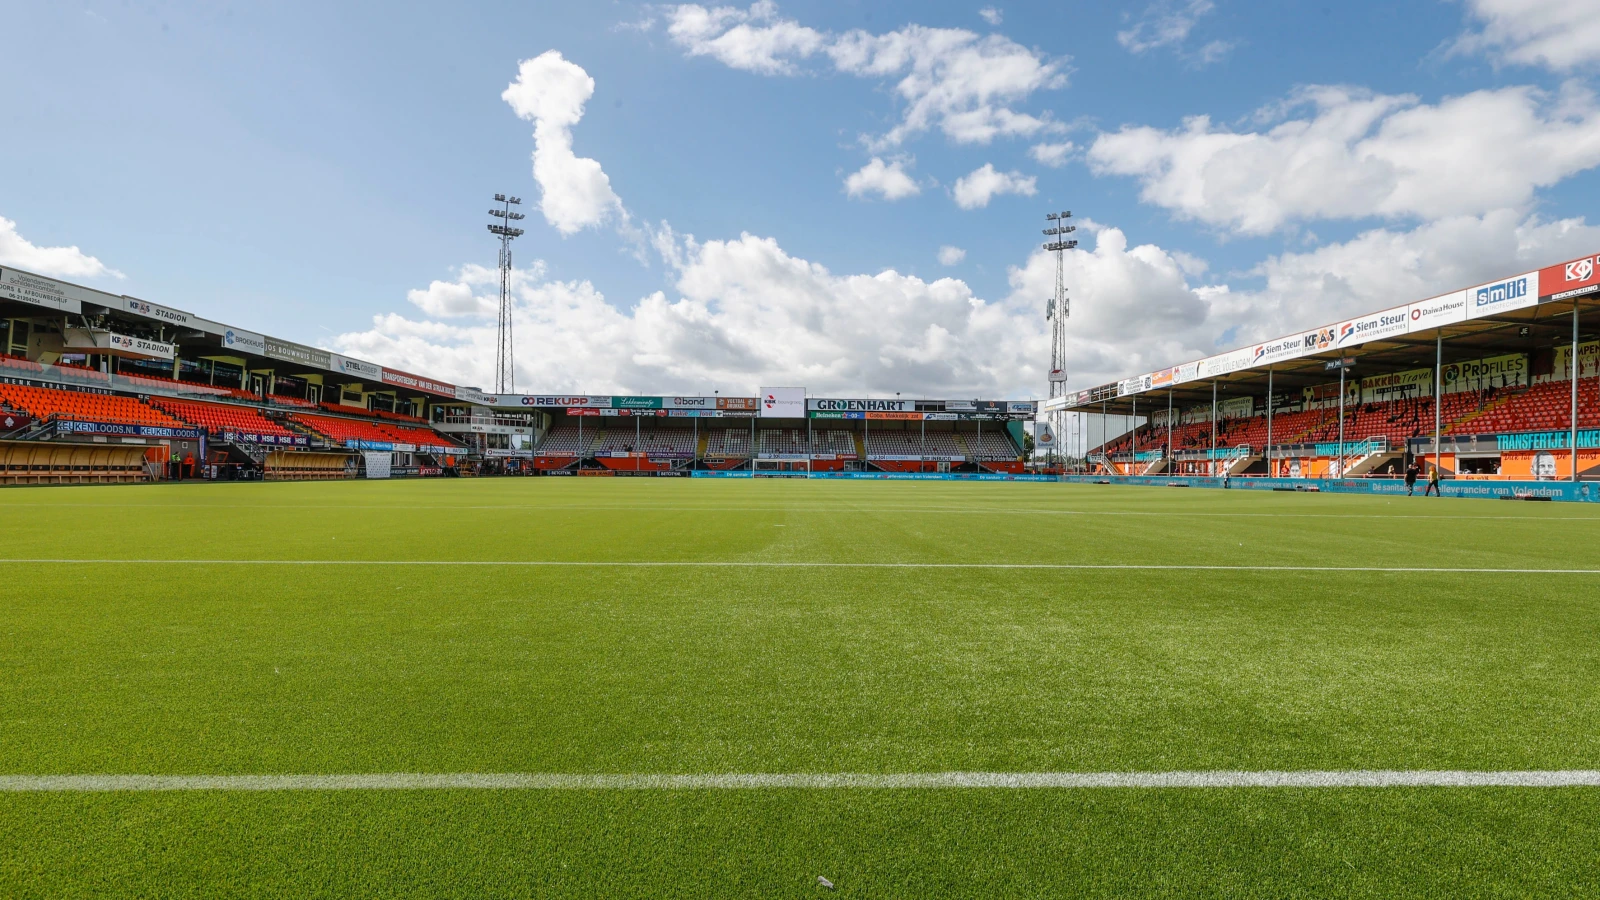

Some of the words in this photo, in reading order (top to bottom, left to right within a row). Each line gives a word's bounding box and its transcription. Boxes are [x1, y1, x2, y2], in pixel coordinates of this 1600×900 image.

[24, 290, 68, 304] AFBOUWBEDRIJF
[1478, 280, 1525, 305] smit
[130, 301, 150, 314] KRAS
[155, 308, 187, 323] STADION
[1355, 323, 1406, 340] STAALCONSTRUCTIES
[1356, 320, 1378, 333] Siem
[1380, 313, 1406, 327] Steur
[112, 335, 133, 347] KRAS
[137, 341, 170, 354] STADION
[235, 336, 264, 349] BROEKHUIS
[1266, 344, 1282, 355] Siem
[1283, 339, 1302, 351] Steur
[1305, 329, 1334, 348] KRAS
[265, 343, 276, 351] JOS
[278, 347, 310, 360] BOUWHUIS
[311, 354, 331, 364] TUINEN
[1266, 348, 1302, 360] STAALCONSTRUCTIES
[1208, 364, 1222, 375] HOTEL
[1223, 357, 1251, 372] VOLENDAM
[4, 377, 31, 387] HENK
[42, 383, 67, 391] KRAS
[77, 386, 113, 396] TRIBUNE
[383, 371, 417, 387] TRANSPORTBEDRIJF
[1362, 375, 1401, 389] BAKKER
[1402, 371, 1432, 383] Travel
[536, 397, 588, 406] REKUPP
[683, 397, 705, 406] bond
[817, 400, 905, 411] GROENHART
[262, 434, 275, 443] HSB
[279, 435, 291, 444] HSB
[295, 436, 307, 444] HSB
[1497, 432, 1564, 451] TRANSFERTJE
[1373, 483, 1381, 491] Dé
[1492, 487, 1509, 495] van
[1511, 485, 1563, 497] Volendam
